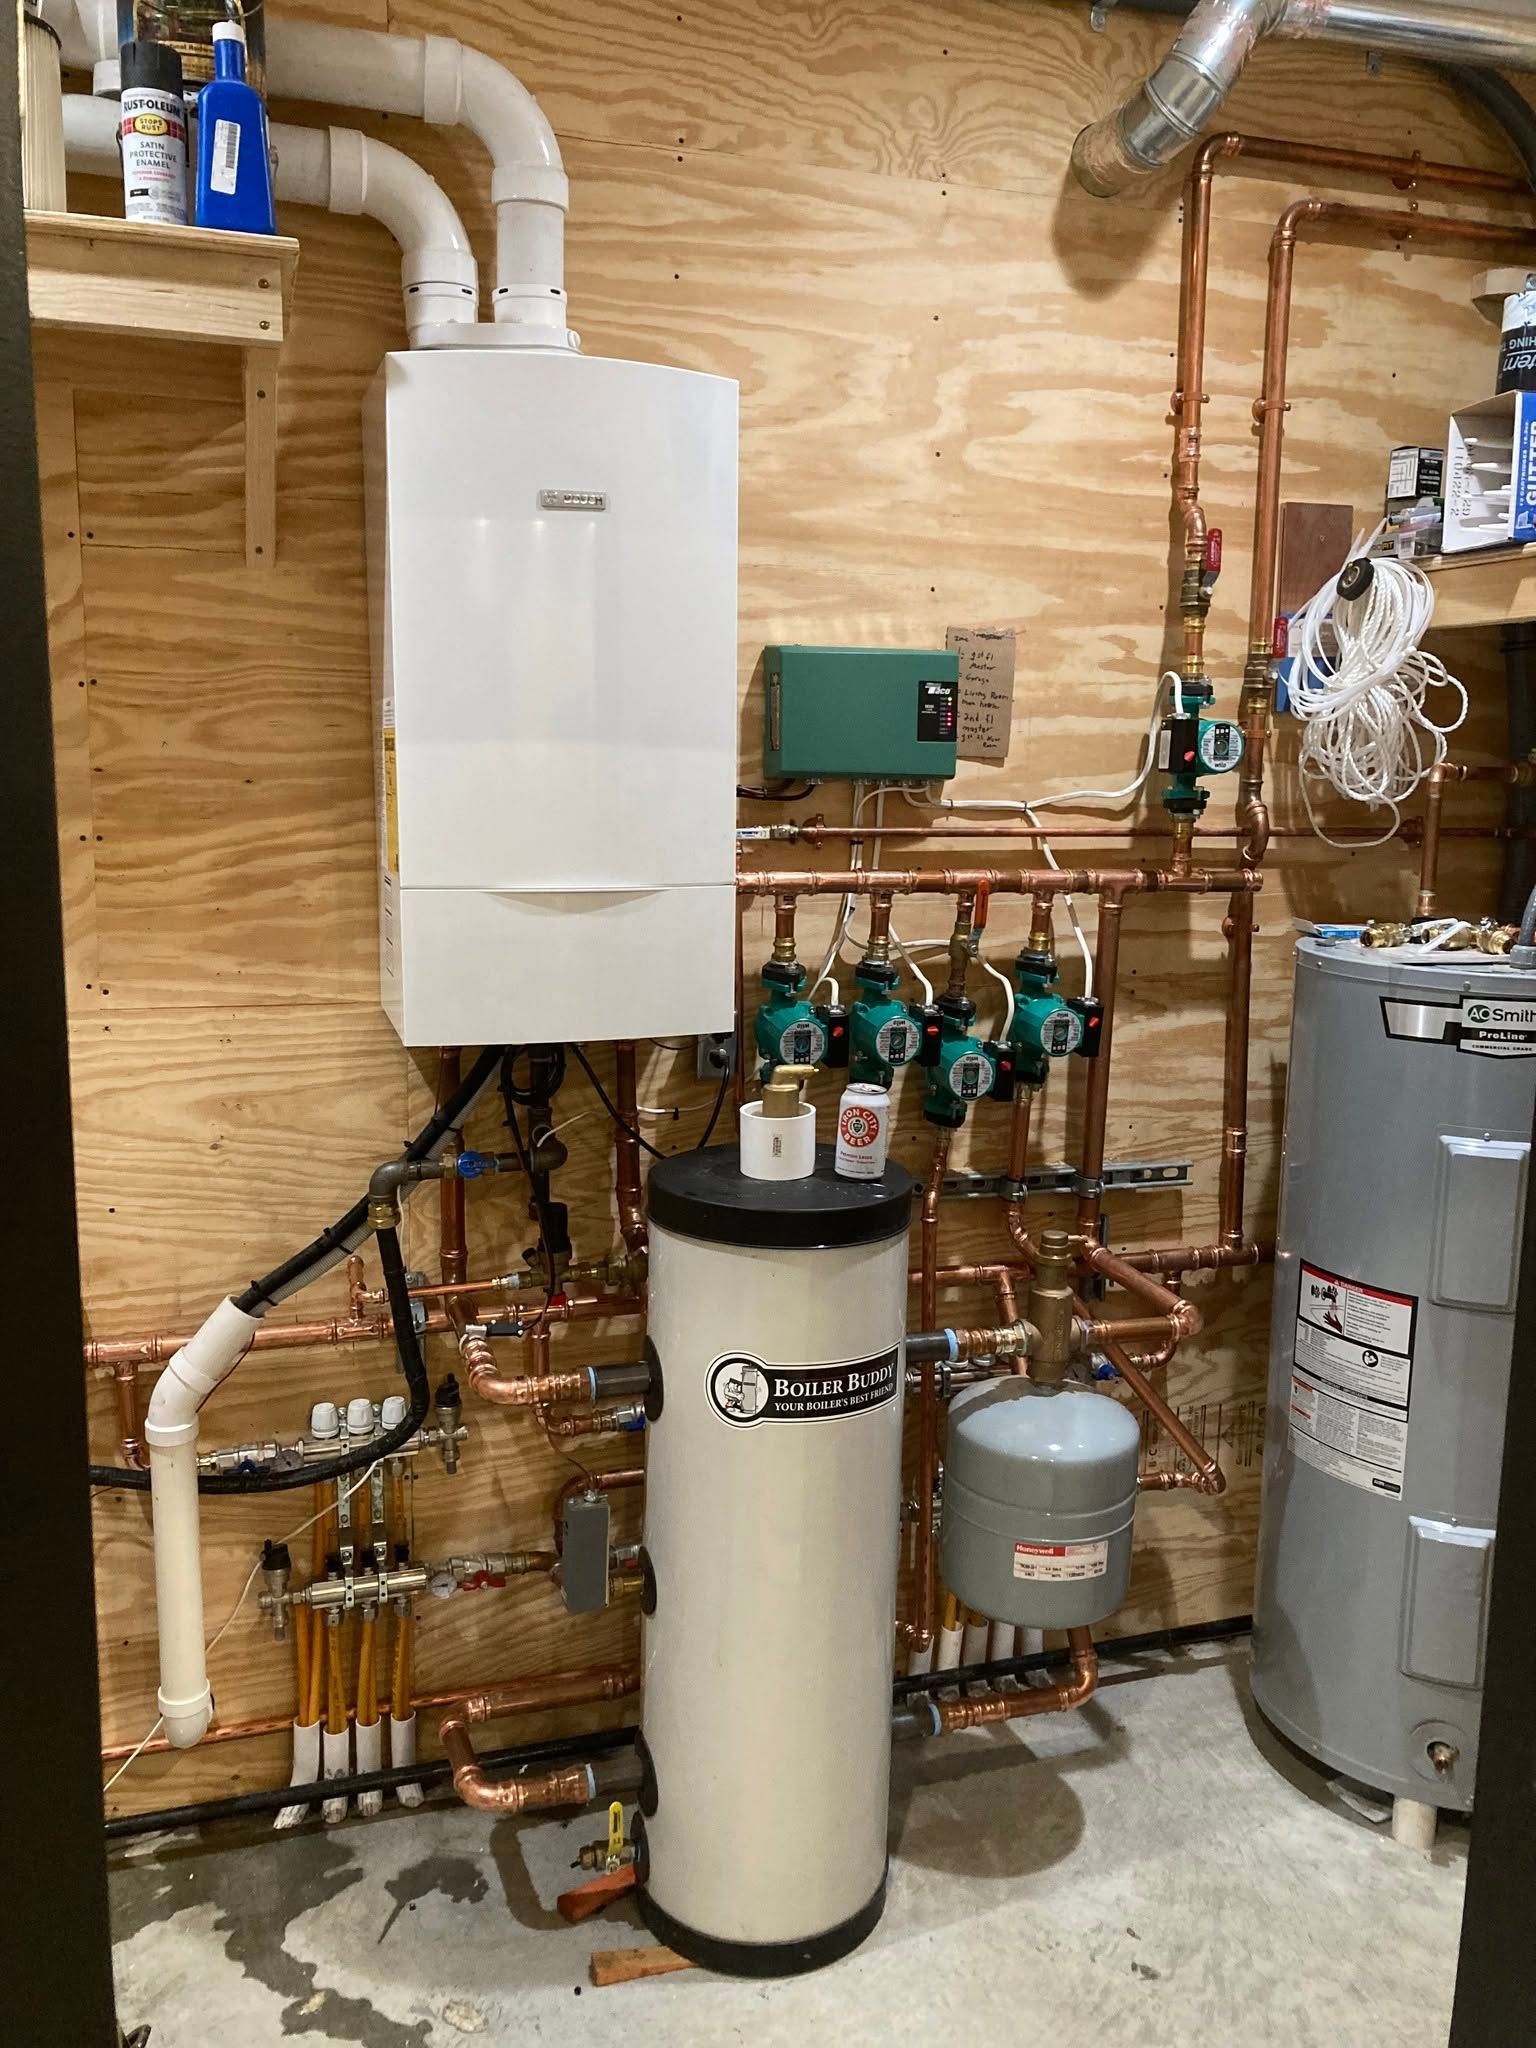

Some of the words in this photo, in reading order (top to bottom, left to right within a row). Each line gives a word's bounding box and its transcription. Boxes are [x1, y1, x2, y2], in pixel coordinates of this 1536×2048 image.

[123, 99, 181, 116] RUST-OLEUM
[140, 118, 163, 126] STOPS
[141, 124, 161, 132] RUST
[140, 141, 165, 150] SATIN
[129, 150, 177, 163] PROTECTIVE
[136, 160, 171, 169] ENAMEL
[563, 494, 604, 505] BOSCH
[925, 682, 951, 695] Taco
[964, 688, 987, 700] Living
[990, 691, 1009, 700] Room
[963, 711, 980, 722] 2nd
[1492, 1008, 1536, 1022] Smith
[1479, 1031, 1526, 1040] ProLine
[841, 1108, 860, 1126] IRON
[862, 1111, 878, 1130] CITY
[843, 1133, 871, 1146] BEER
[774, 1378, 844, 1397] BOILER
[847, 1363, 895, 1392] BUDDY
[774, 1402, 804, 1412] YOUR
[806, 1398, 849, 1412] BOILER'S
[850, 1394, 869, 1406] BEST
[870, 1382, 894, 1401] FRIEND
[1016, 1544, 1054, 1556] Honeywell
